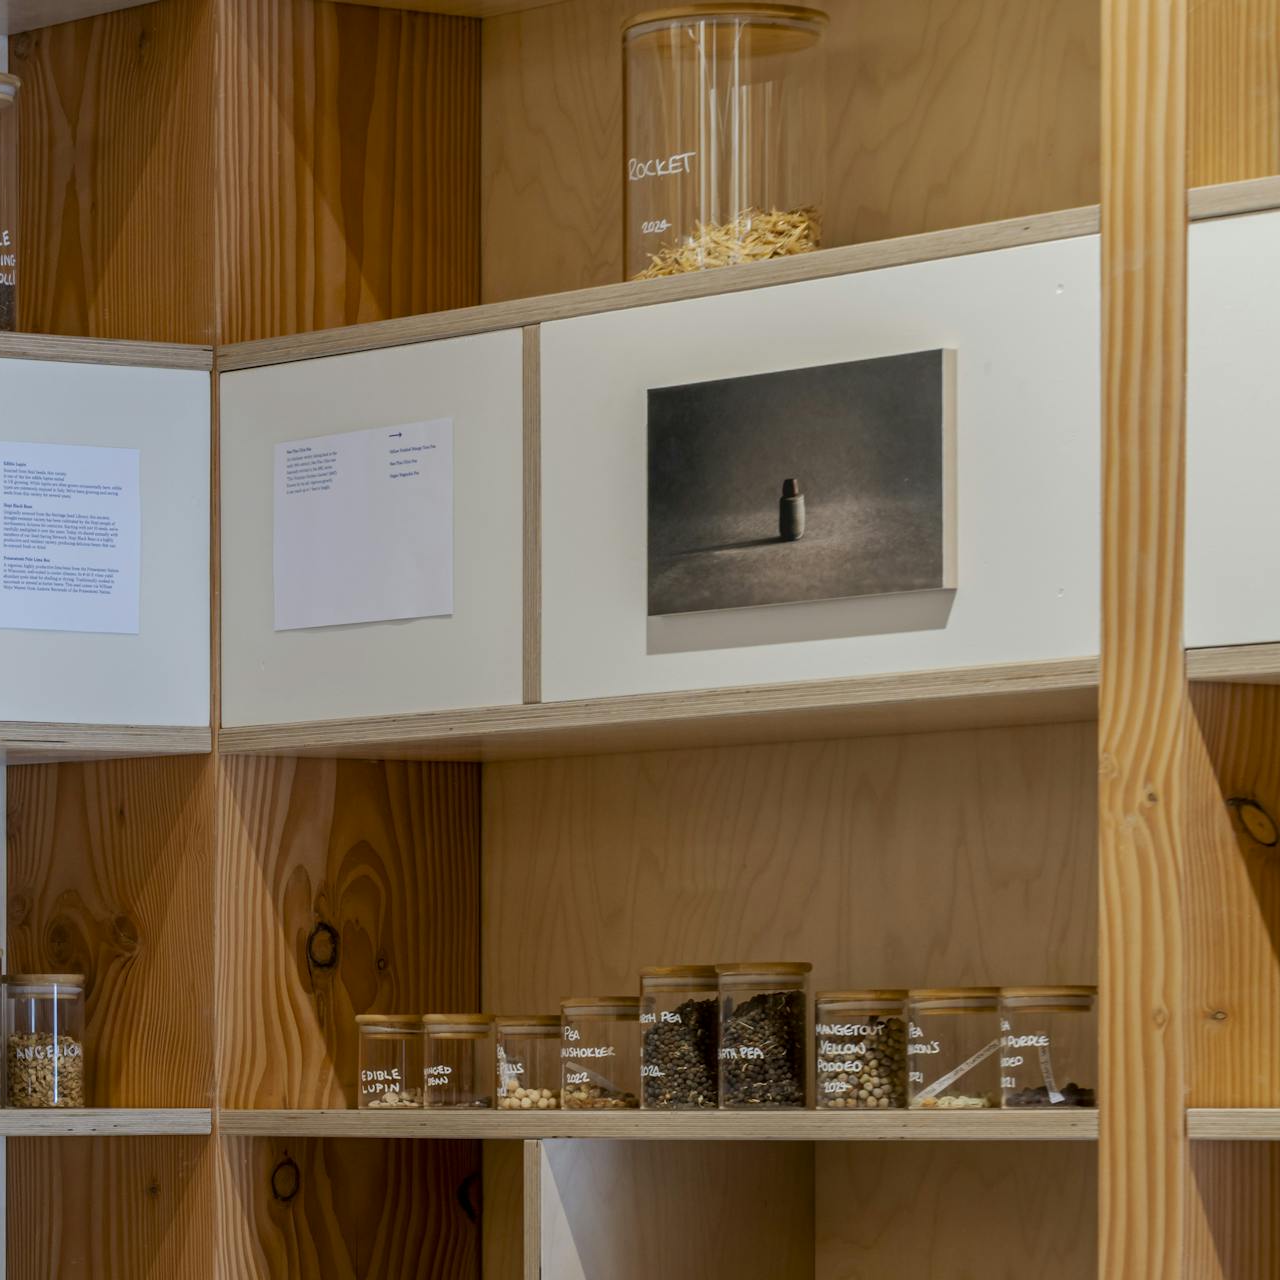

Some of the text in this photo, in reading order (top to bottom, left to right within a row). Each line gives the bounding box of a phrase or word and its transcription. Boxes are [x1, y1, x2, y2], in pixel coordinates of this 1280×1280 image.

[628, 152, 696, 180] ROCKET
[739, 1047, 764, 1060] PEA
[820, 1040, 866, 1055] YELLOW
[361, 1068, 402, 1082] EDIBLE
[362, 1082, 400, 1094] LUPIN
